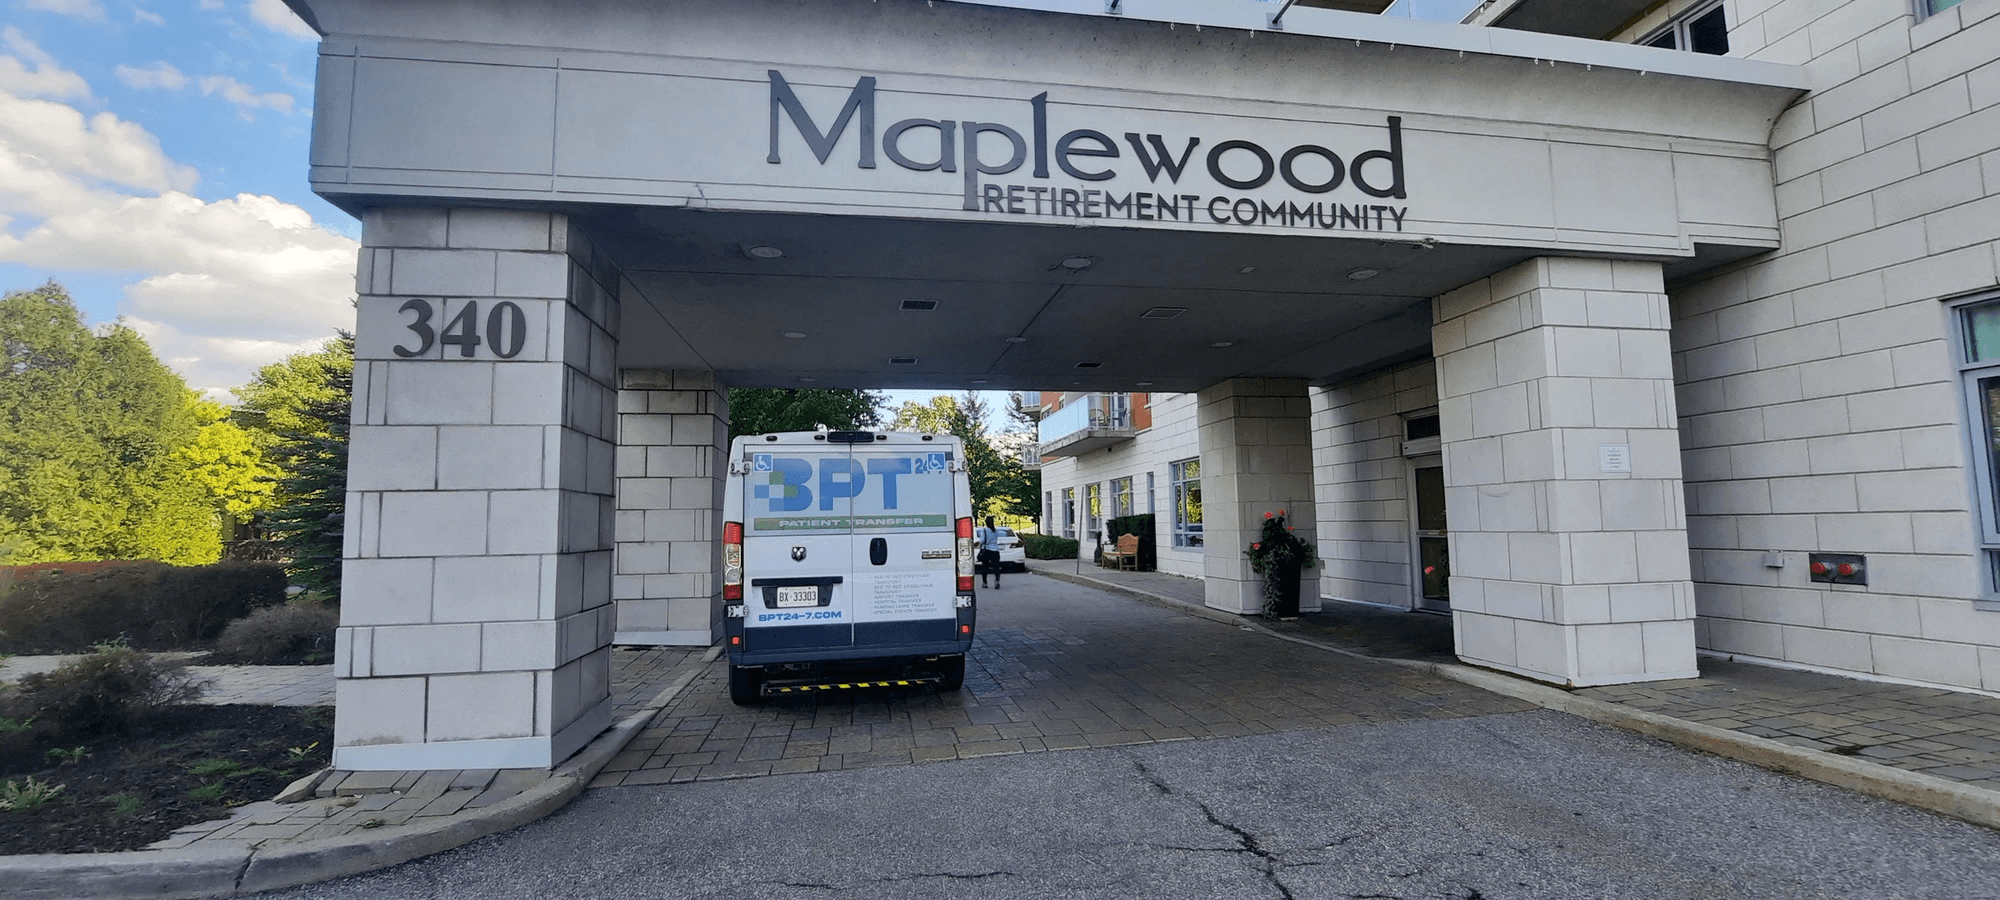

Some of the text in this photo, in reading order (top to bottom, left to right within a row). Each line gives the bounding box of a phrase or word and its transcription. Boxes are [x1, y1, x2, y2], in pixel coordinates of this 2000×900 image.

[767, 69, 1407, 211] Maplewood
[983, 183, 1408, 232] RETIREMENT COMMUNITY
[393, 299, 526, 359] 340
[755, 457, 912, 512] BPT
[780, 517, 924, 527] PATIENT TRANSFER
[758, 610, 842, 622] BPT24-7.COM
[793, 591, 817, 602] 33303
